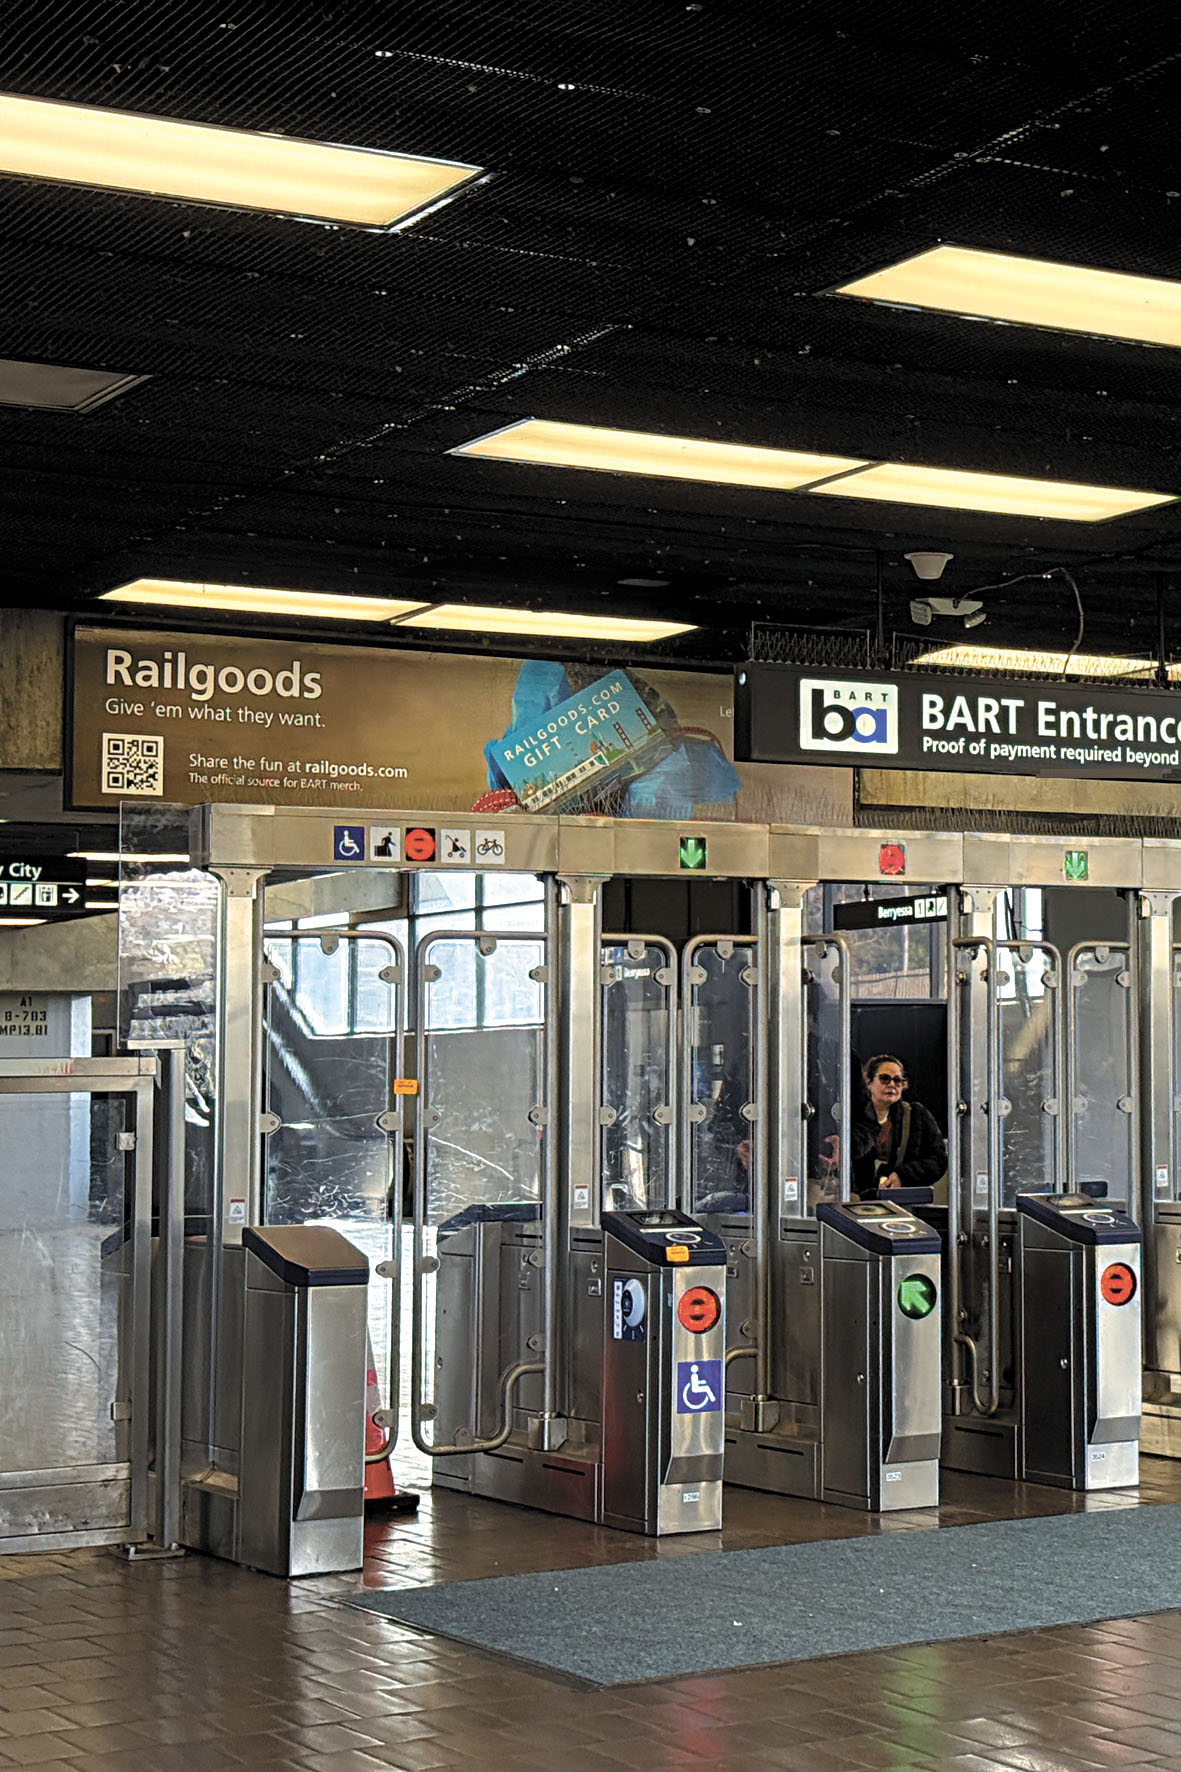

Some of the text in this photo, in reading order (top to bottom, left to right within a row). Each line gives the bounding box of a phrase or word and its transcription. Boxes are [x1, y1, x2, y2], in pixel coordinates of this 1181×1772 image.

[106, 649, 322, 701] Railgoods
[833, 689, 889, 702] BART
[105, 698, 326, 728] Give 'em what they want.
[504, 681, 623, 762] RAILGOODS.COM
[720, 705, 734, 718] Le
[922, 693, 1025, 736] BART
[522, 700, 621, 768] GIFT CARD
[922, 736, 966, 755] Proof
[969, 738, 987, 755] of
[990, 743, 1056, 760] payment
[1060, 745, 1122, 764] required
[1126, 747, 1179, 768] beyond
[188, 753, 408, 778] Share the fun at railgoods.com
[188, 773, 208, 784] The
[210, 773, 245, 786] official
[247, 776, 280, 788] source
[283, 776, 298, 788] for
[330, 780, 364, 792] merch.
[9, 862, 42, 882] City
[878, 906, 913, 920] Berryessa
[20, 996, 32, 1007] A1
